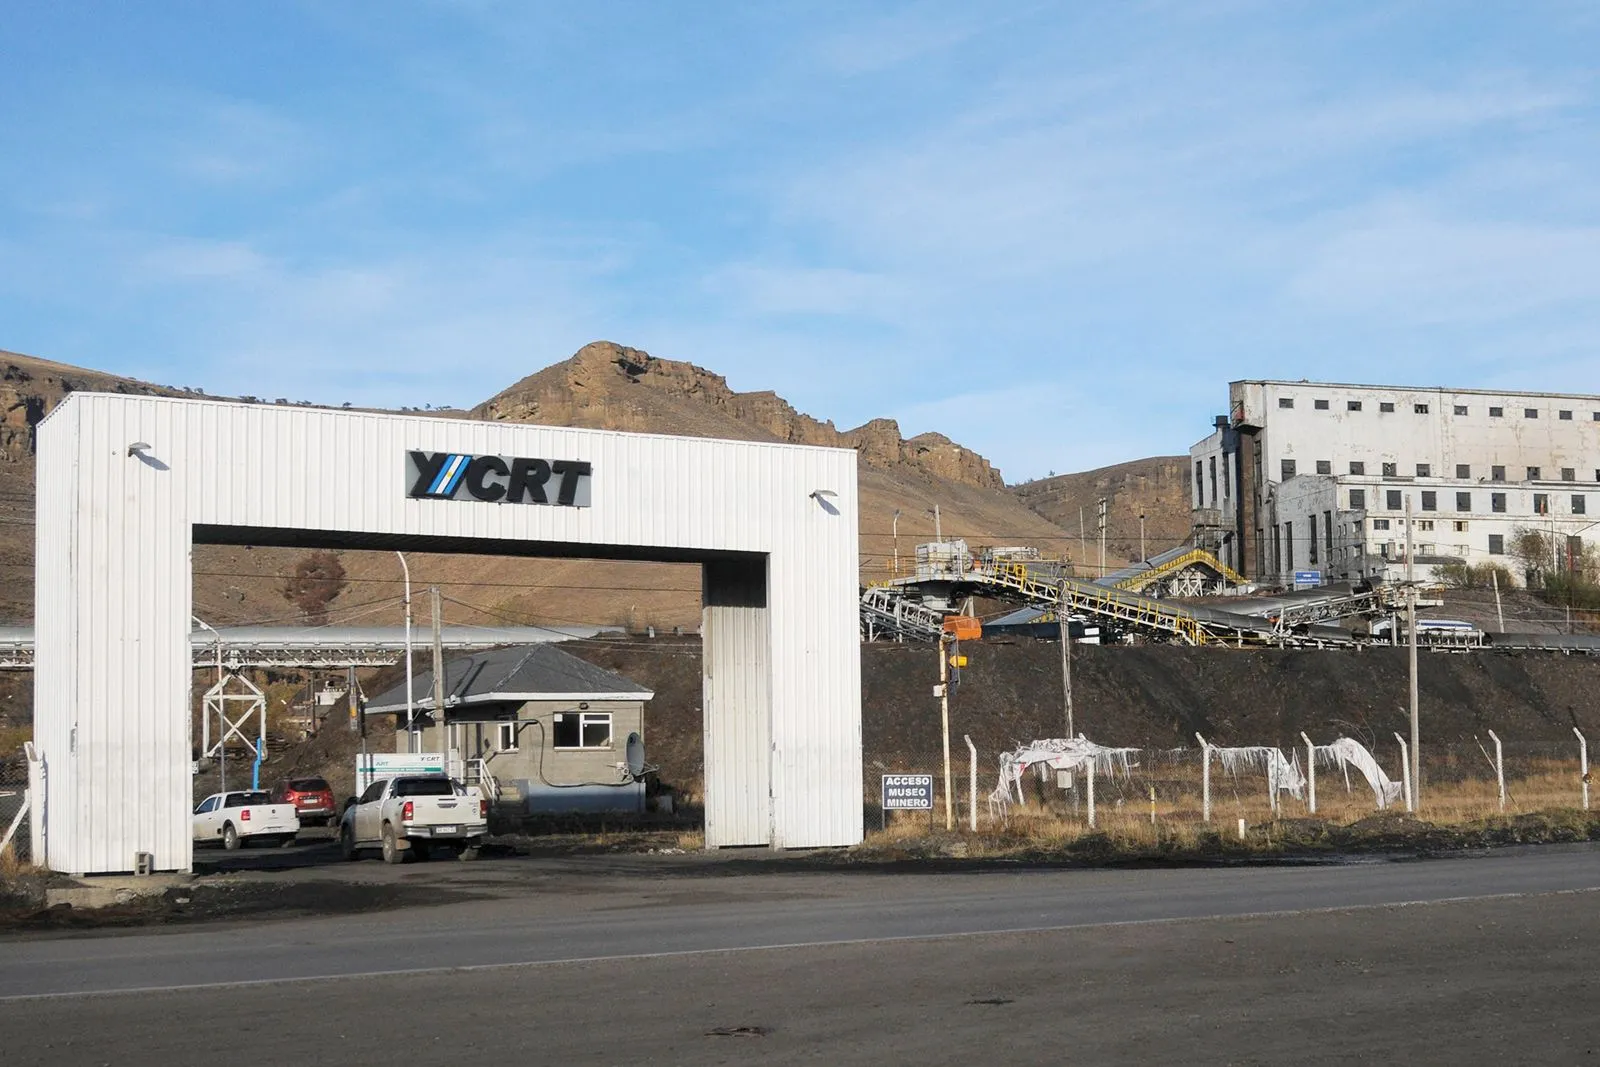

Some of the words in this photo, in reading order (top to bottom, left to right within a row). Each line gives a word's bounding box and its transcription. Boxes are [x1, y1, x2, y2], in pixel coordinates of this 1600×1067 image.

[886, 777, 930, 786] ACCESO
[888, 788, 926, 797] MUSEO
[887, 798, 928, 807] MINERO
